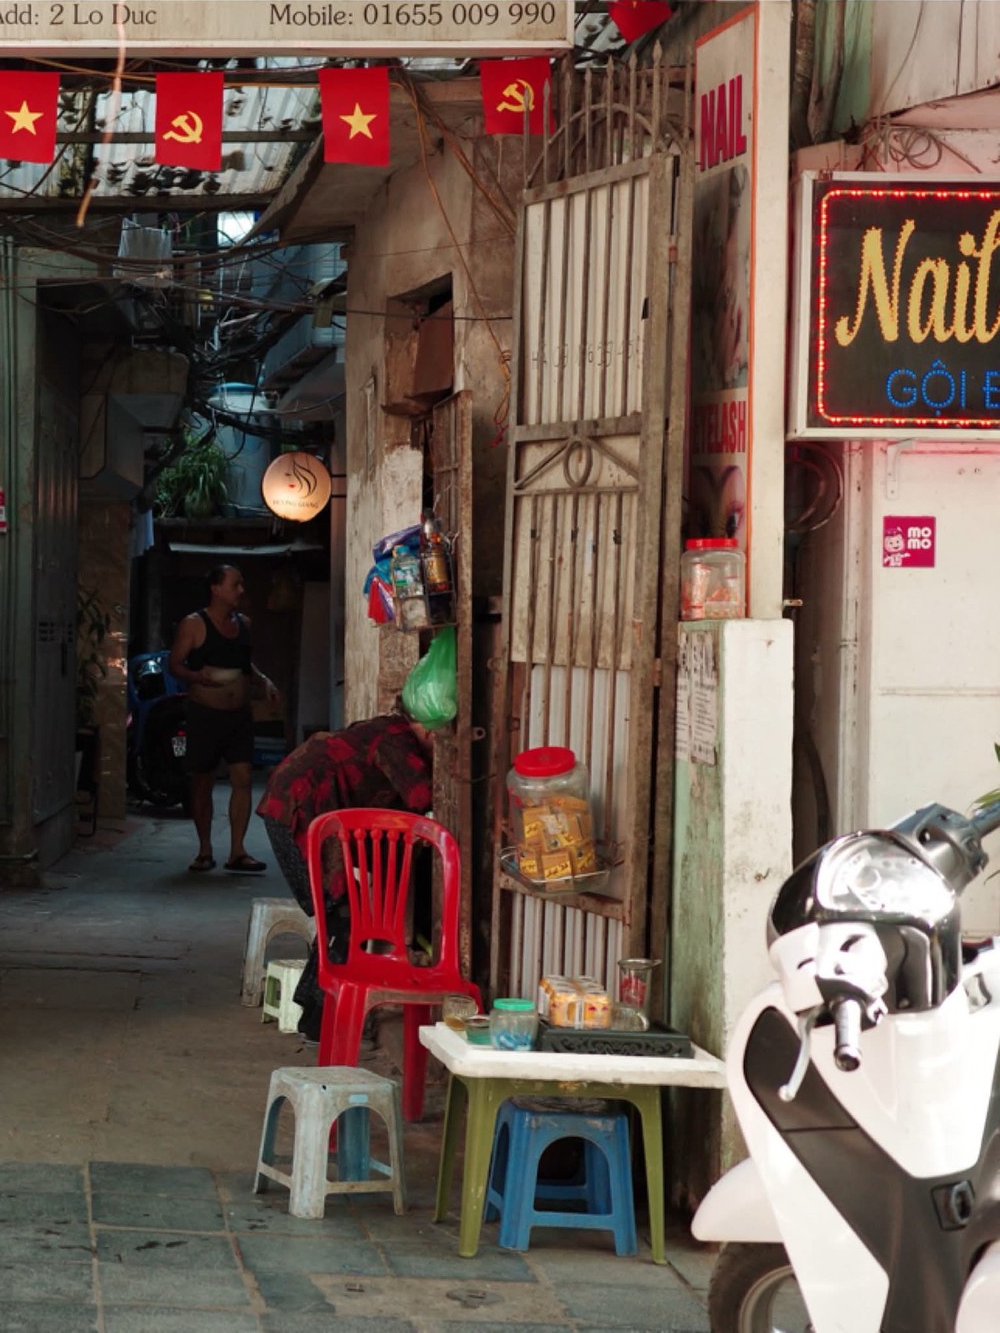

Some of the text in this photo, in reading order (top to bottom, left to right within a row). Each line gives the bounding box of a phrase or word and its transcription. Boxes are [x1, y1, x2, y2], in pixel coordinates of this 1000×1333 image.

[49, 4, 64, 25] 2
[73, 4, 103, 25] Lo
[111, 4, 157, 25] Duc
[269, 2, 556, 26] Mobile: 01655 009 990
[700, 73, 747, 172] NAIL
[886, 358, 966, 416] GỘI
